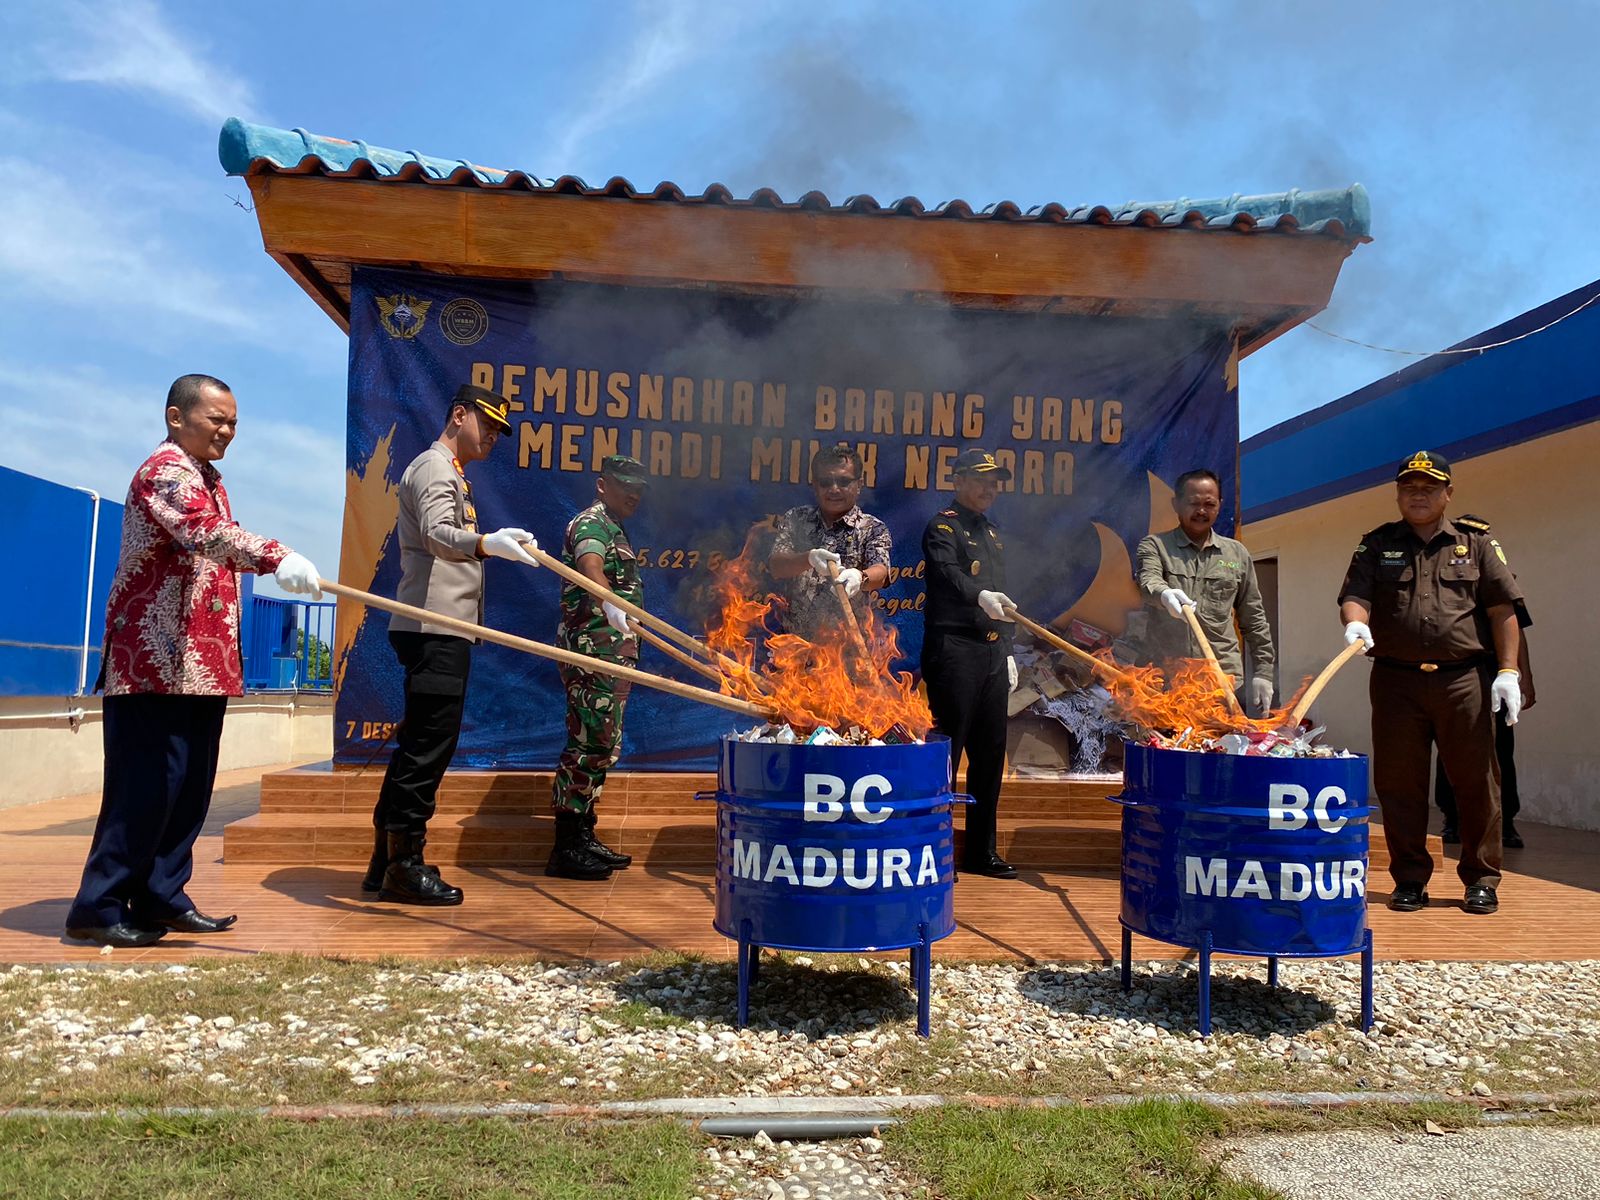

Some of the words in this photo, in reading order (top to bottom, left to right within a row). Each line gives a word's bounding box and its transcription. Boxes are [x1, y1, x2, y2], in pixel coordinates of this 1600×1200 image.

[471, 362, 788, 428] PEMUSNAHAN
[814, 385, 986, 439] BARANG
[1012, 395, 1125, 444] YANG
[750, 437, 878, 488] MIK
[904, 444, 1075, 496] NEARA
[346, 721, 356, 739] 7
[362, 722, 397, 739] DES
[803, 773, 895, 824] BC
[1268, 783, 1348, 834] BC
[732, 838, 939, 889] MADURA
